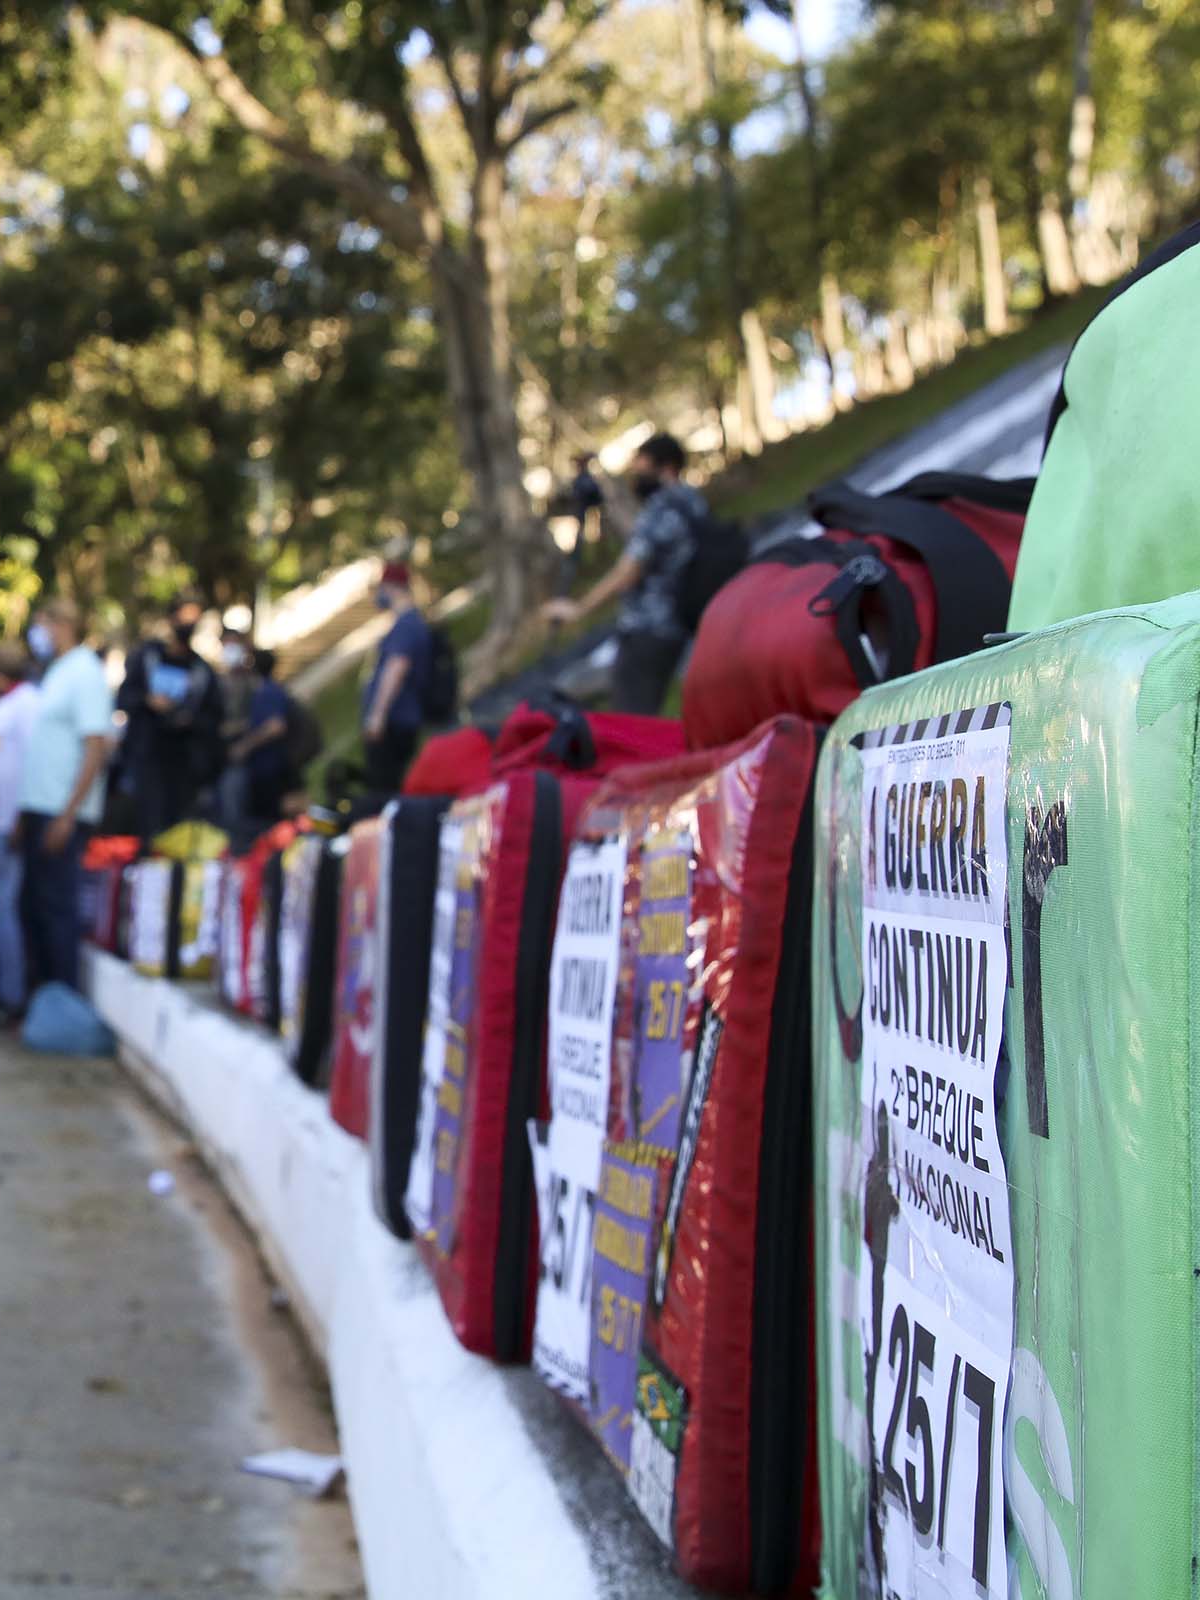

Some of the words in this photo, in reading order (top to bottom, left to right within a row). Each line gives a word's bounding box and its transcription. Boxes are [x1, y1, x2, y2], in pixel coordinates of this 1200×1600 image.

[866, 785, 878, 891] A
[884, 774, 989, 899] GUERRA
[867, 921, 988, 1064] CONTINUA
[906, 1063, 990, 1174] BREQUE
[904, 1149, 1005, 1265] NACIONAL
[881, 1302, 996, 1590] 25/7
